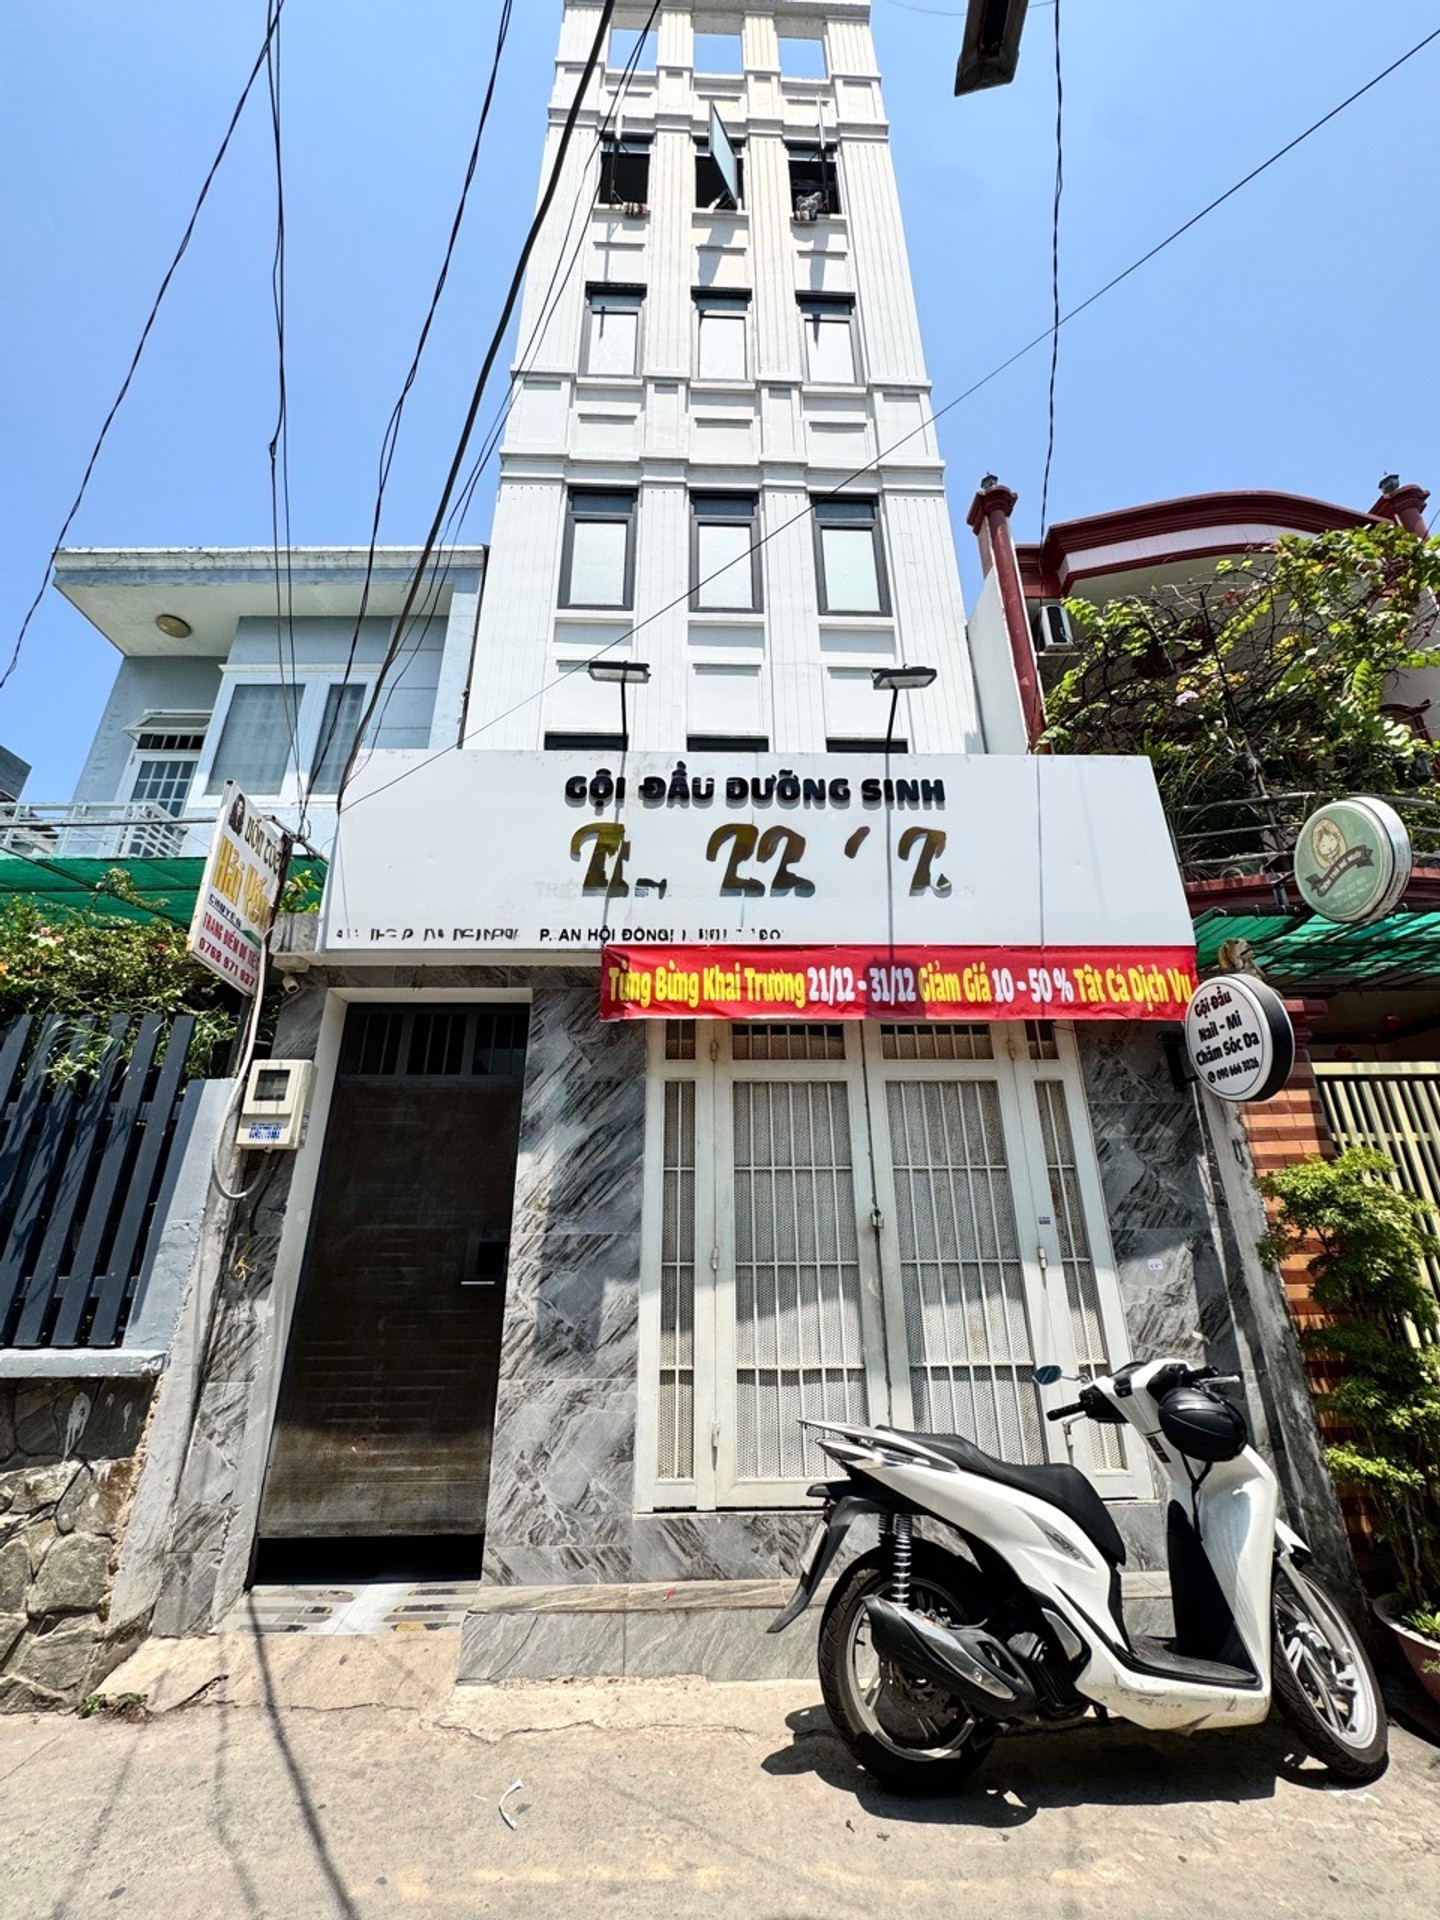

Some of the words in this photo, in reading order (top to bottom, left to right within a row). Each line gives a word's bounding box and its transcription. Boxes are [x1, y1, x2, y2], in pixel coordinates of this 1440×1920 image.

[565, 768, 626, 807] GỘI
[861, 778, 945, 802] SINH
[558, 928, 581, 941] AN
[703, 962, 740, 1001] Khai
[807, 965, 855, 1006] 21/12
[869, 965, 916, 1006] 31/12
[918, 960, 961, 1002] Giảm
[992, 967, 1014, 1003] 10
[1128, 963, 1170, 1012] Dịch
[1194, 997, 1211, 1019] Gội
[1198, 1021, 1219, 1042] Nail
[1225, 1010, 1242, 1030] Mi
[1222, 1036, 1243, 1056] Sóc
[1242, 1031, 1260, 1048] Da
